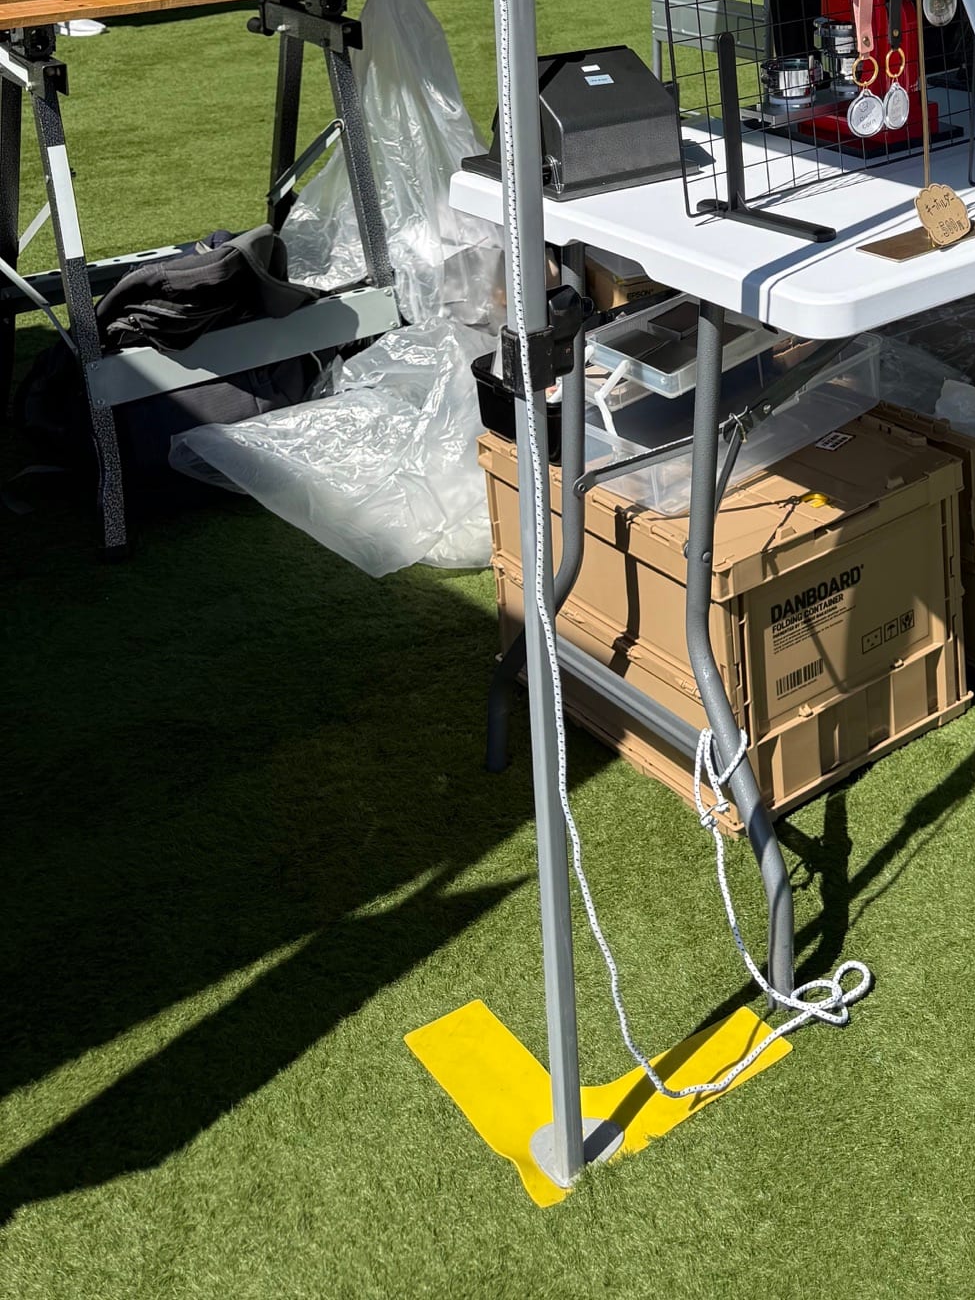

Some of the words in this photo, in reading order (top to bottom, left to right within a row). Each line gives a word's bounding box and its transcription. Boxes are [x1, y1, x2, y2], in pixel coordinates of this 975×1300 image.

[771, 566, 861, 624] DANBOARD
[772, 613, 803, 633] FOLDING
[803, 593, 844, 618] CONTAINER
